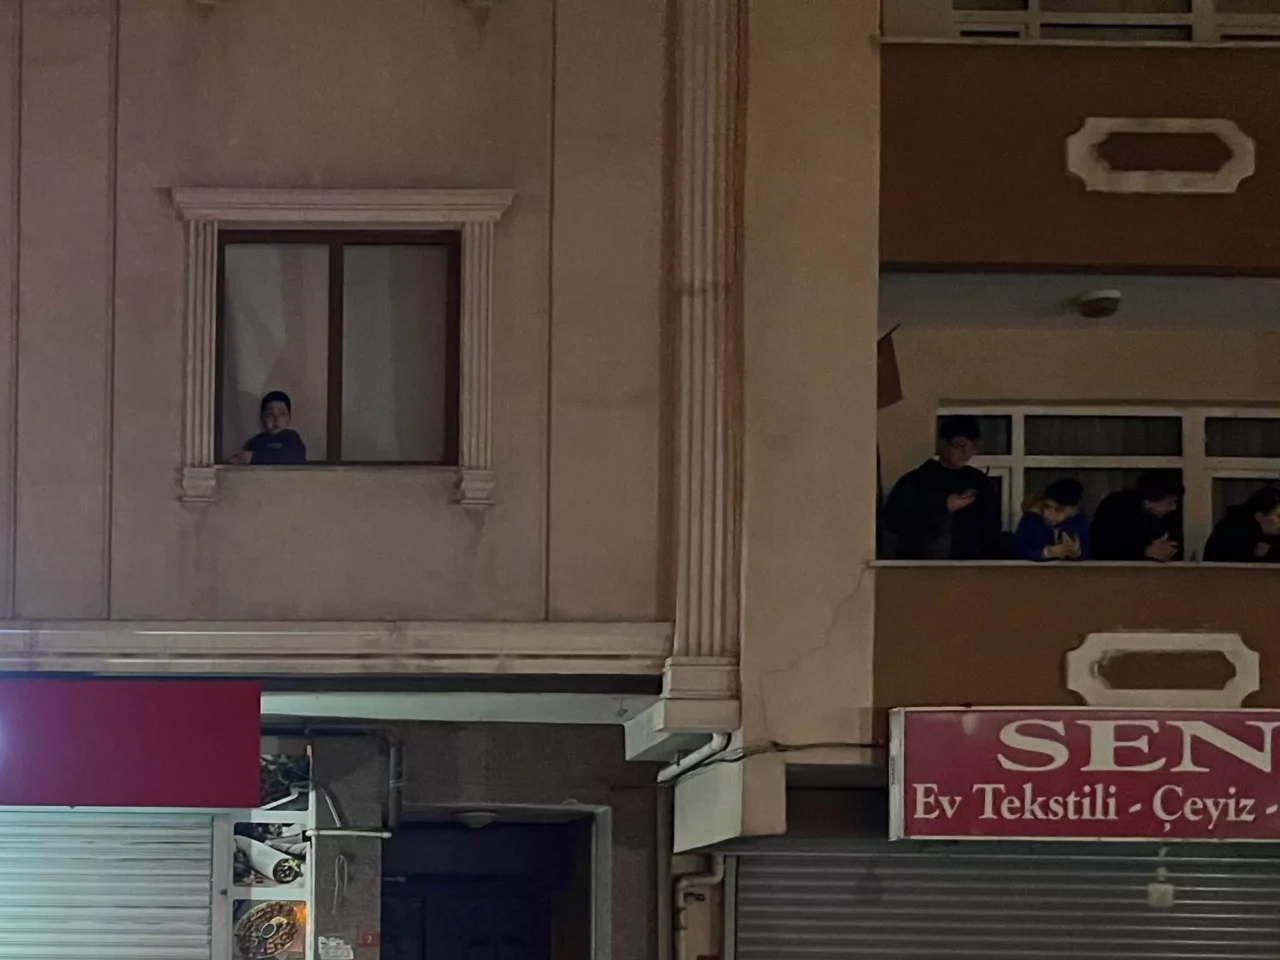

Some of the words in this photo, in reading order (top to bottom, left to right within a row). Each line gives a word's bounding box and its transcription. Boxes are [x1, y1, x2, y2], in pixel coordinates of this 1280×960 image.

[913, 783, 962, 819] Ev
[972, 782, 1118, 820] Tekstili
[1152, 784, 1256, 832] Çeyiz
